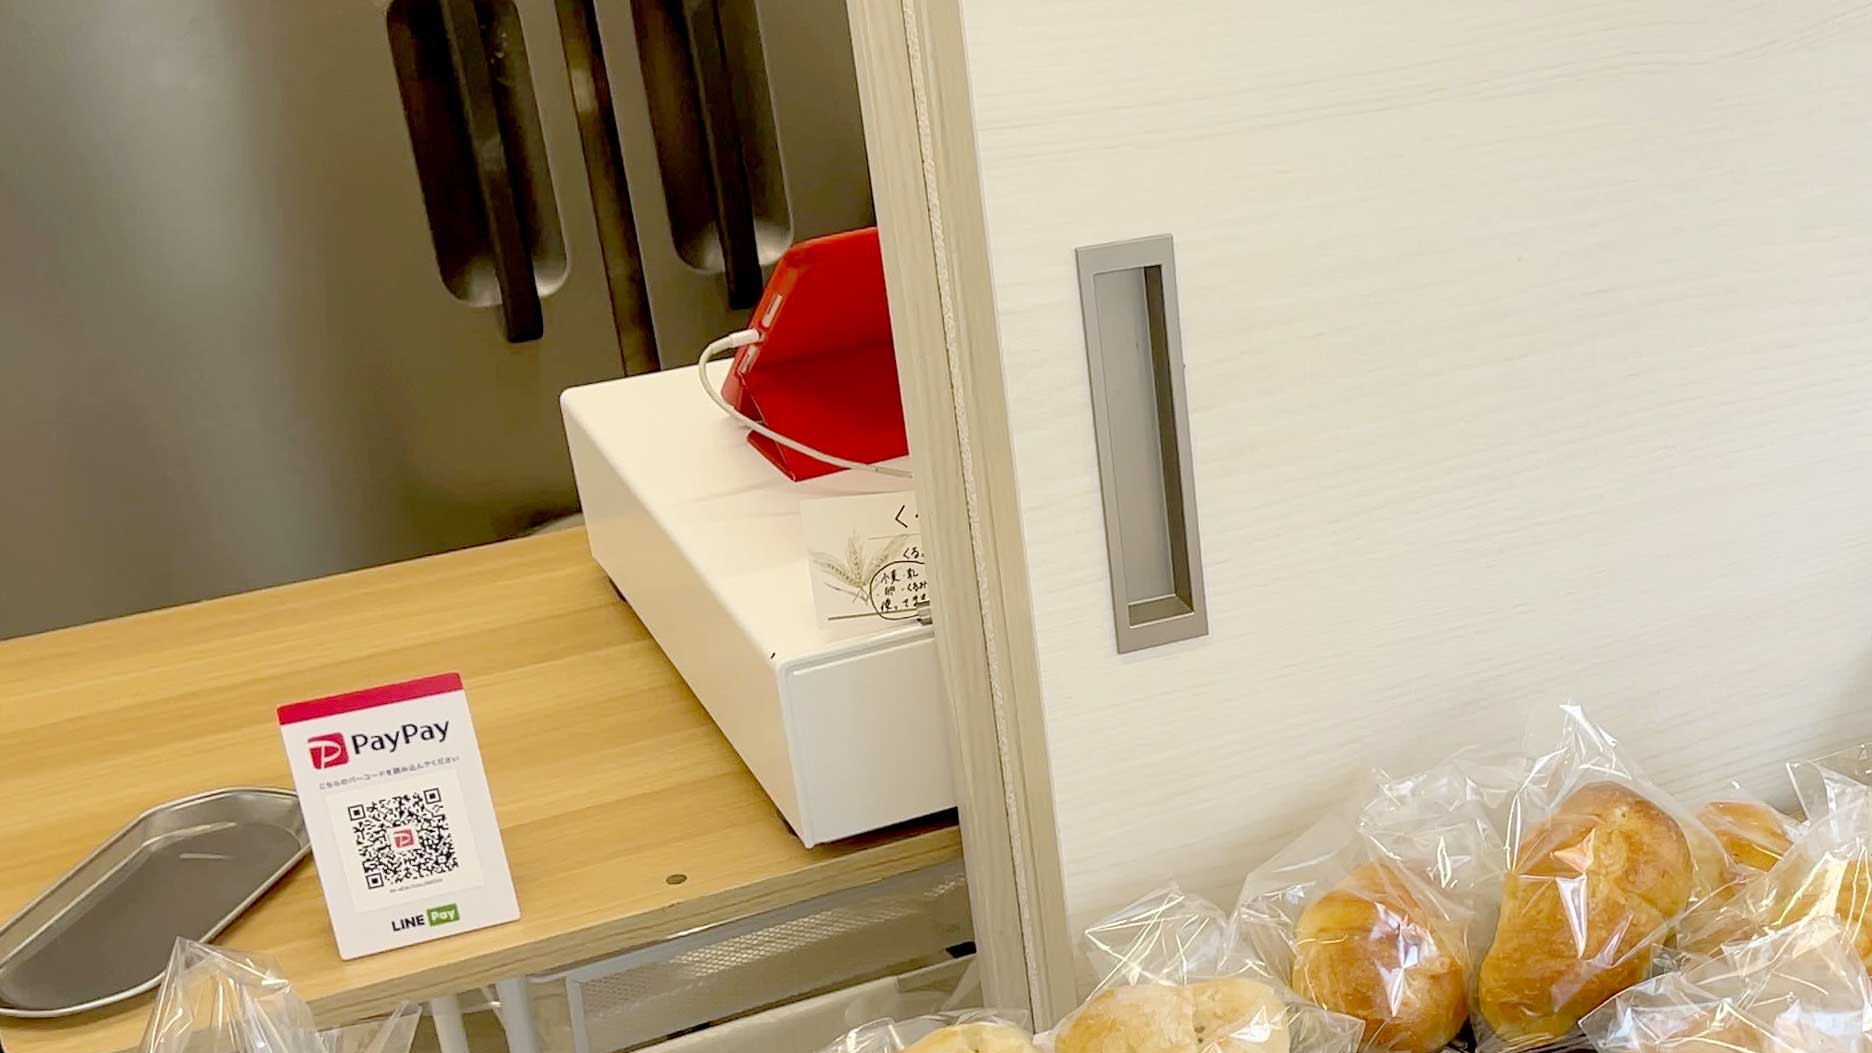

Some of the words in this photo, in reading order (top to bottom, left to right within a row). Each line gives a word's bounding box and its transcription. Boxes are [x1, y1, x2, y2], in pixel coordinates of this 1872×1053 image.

[352, 720, 449, 755] PayPay
[391, 914, 425, 932] LINE
[430, 907, 456, 922] Pay
